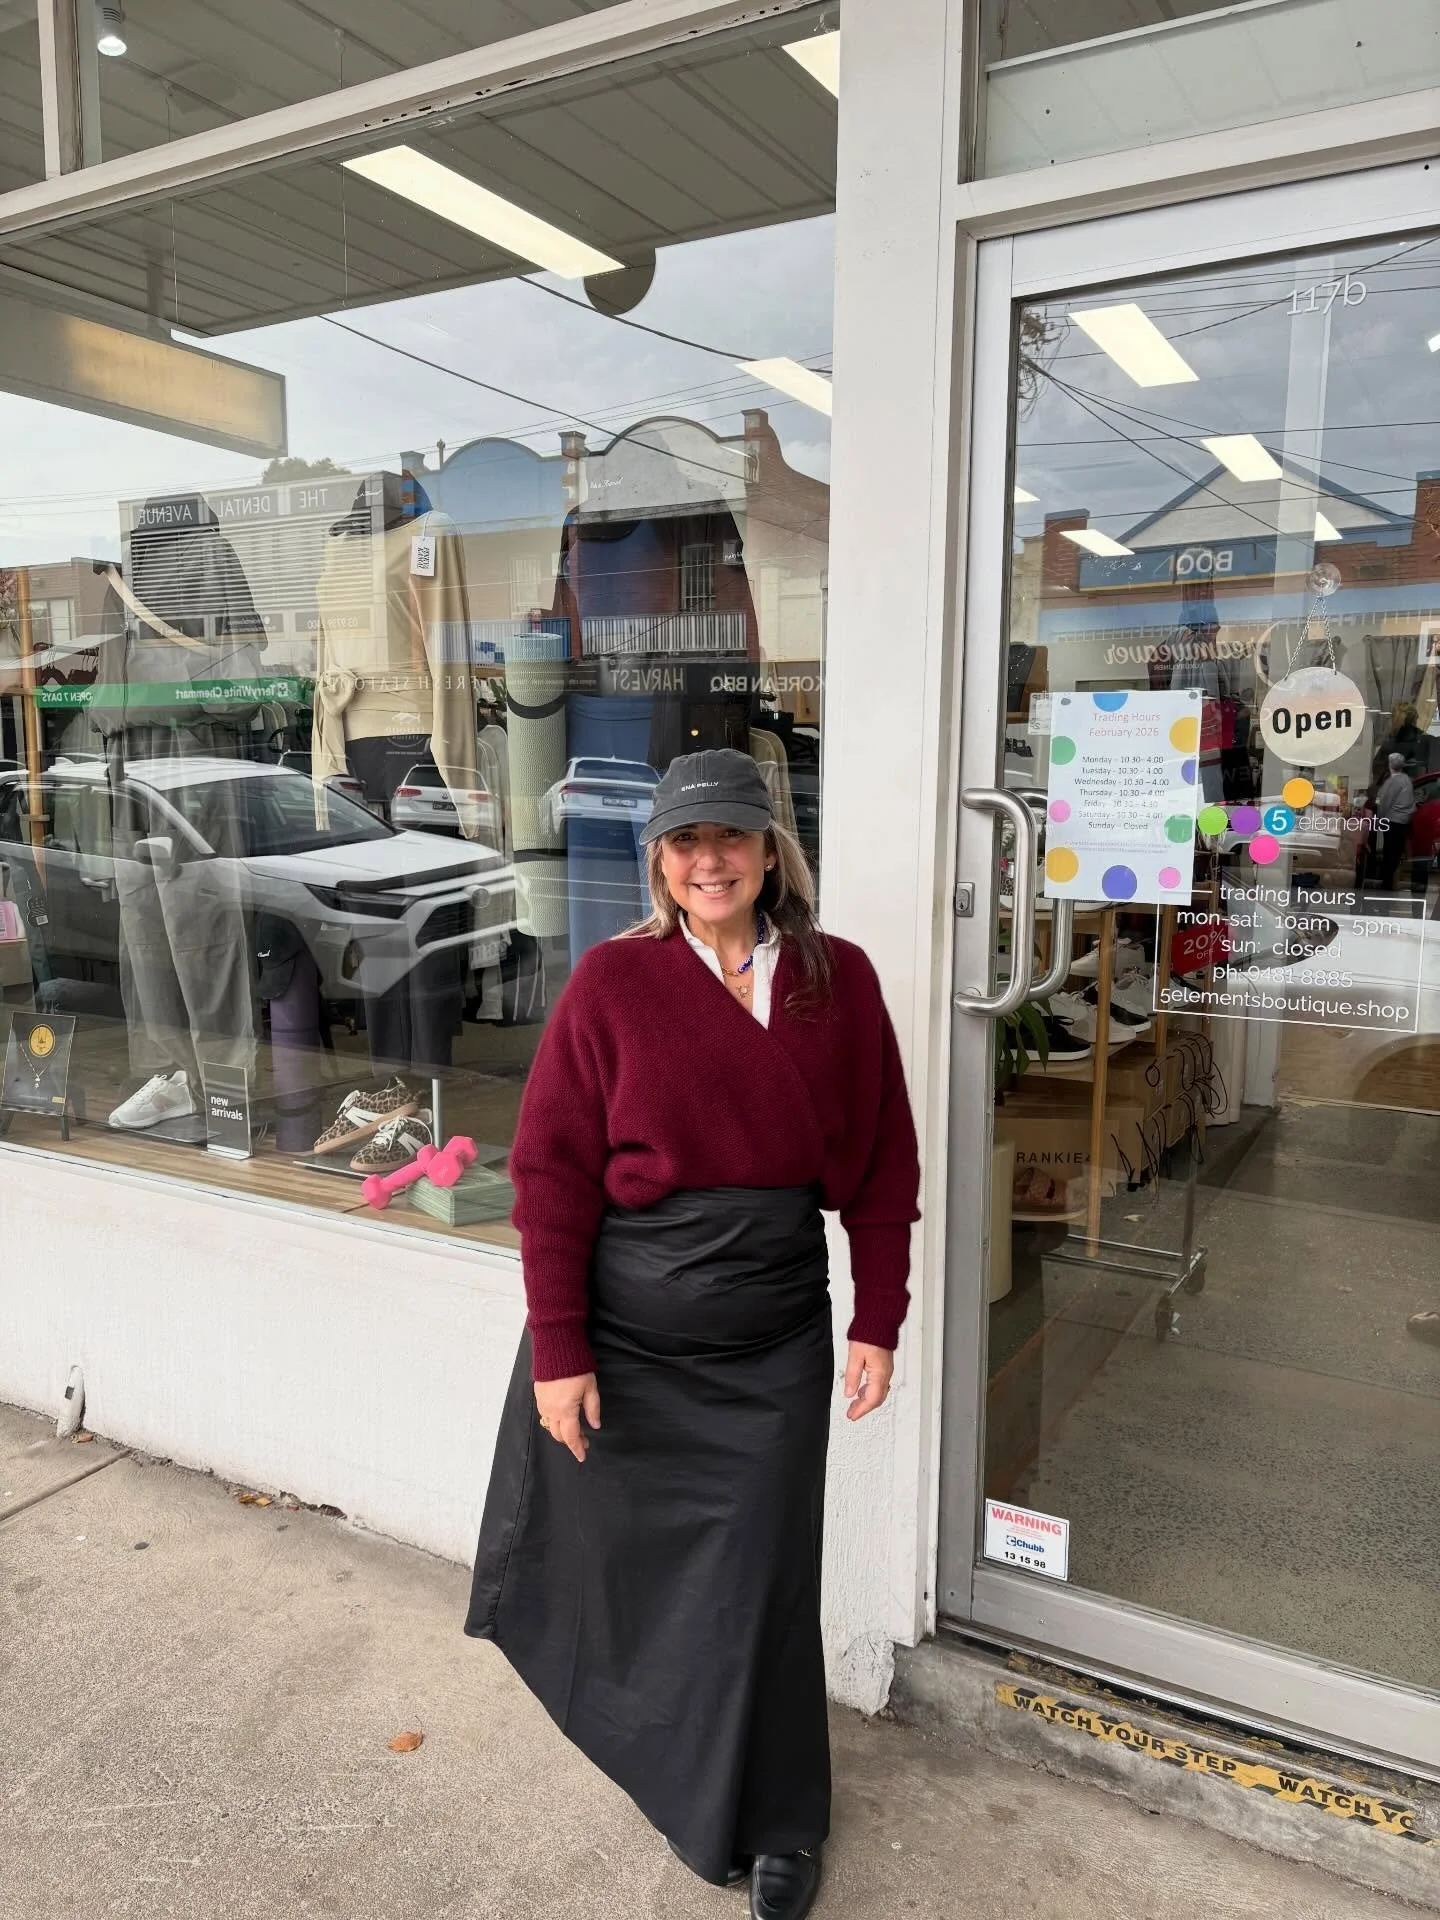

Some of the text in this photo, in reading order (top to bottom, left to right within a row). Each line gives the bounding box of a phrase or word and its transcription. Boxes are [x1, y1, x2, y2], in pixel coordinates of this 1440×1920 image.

[1287, 274, 1367, 316] 117b
[1093, 712, 1161, 724] Trading Hours
[1272, 707, 1352, 739] Open
[1089, 727, 1159, 739] February 2026
[1082, 756, 1112, 765] Monday
[1082, 767, 1111, 776] Tuesday
[1074, 778, 1117, 787] Wednesday
[1080, 788, 1112, 797] Thursday
[1083, 800, 1105, 808] Friday
[1078, 811, 1111, 820] Saturday
[1271, 809, 1390, 832] 5 elements
[1088, 821, 1116, 830] Sunday
[1123, 822, 1149, 830] Closed
[1220, 884, 1356, 907] trading hours
[1176, 910, 1263, 928] mon-sat:
[1275, 915, 1331, 932] 10am
[1352, 918, 1401, 937] 5pm
[1221, 938, 1342, 958] sun: closed
[1213, 963, 1353, 988] ph: 9481 8885
[1160, 987, 1410, 1022] 5elementsboutique.shop
[210, 1095, 229, 1107] new
[211, 1107, 243, 1121] arrivals
[991, 1507, 1062, 1536] WARNING
[1016, 1539, 1045, 1553] Chubb
[1004, 1551, 1046, 1569] 13 15 98
[1013, 1694, 1238, 1773] WATCH YOUR STEP
[1277, 1775, 1371, 1816] WATCH
